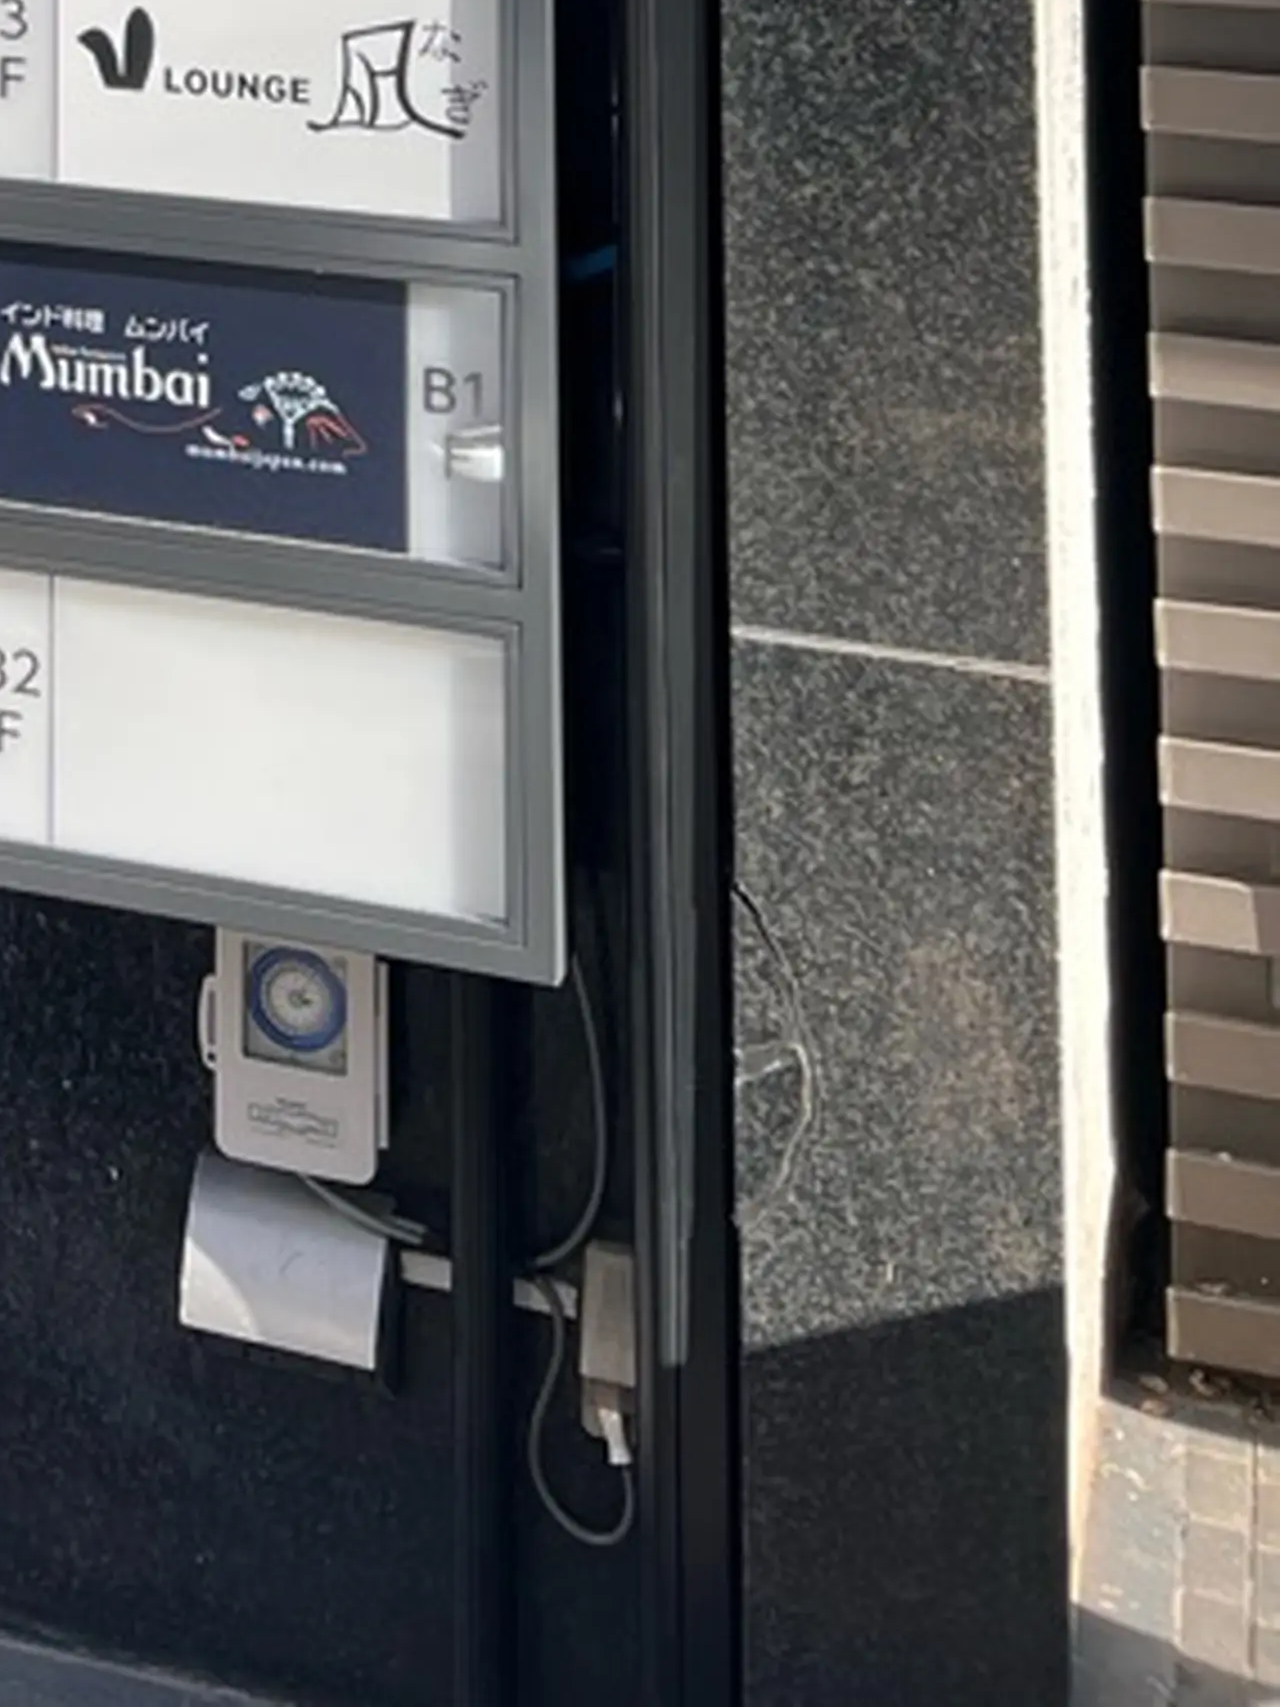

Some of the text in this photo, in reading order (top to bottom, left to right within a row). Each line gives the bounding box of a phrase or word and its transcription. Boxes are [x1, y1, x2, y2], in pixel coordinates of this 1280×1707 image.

[163, 66, 310, 104] LOUNGE
[124, 315, 210, 345] ムンバイ
